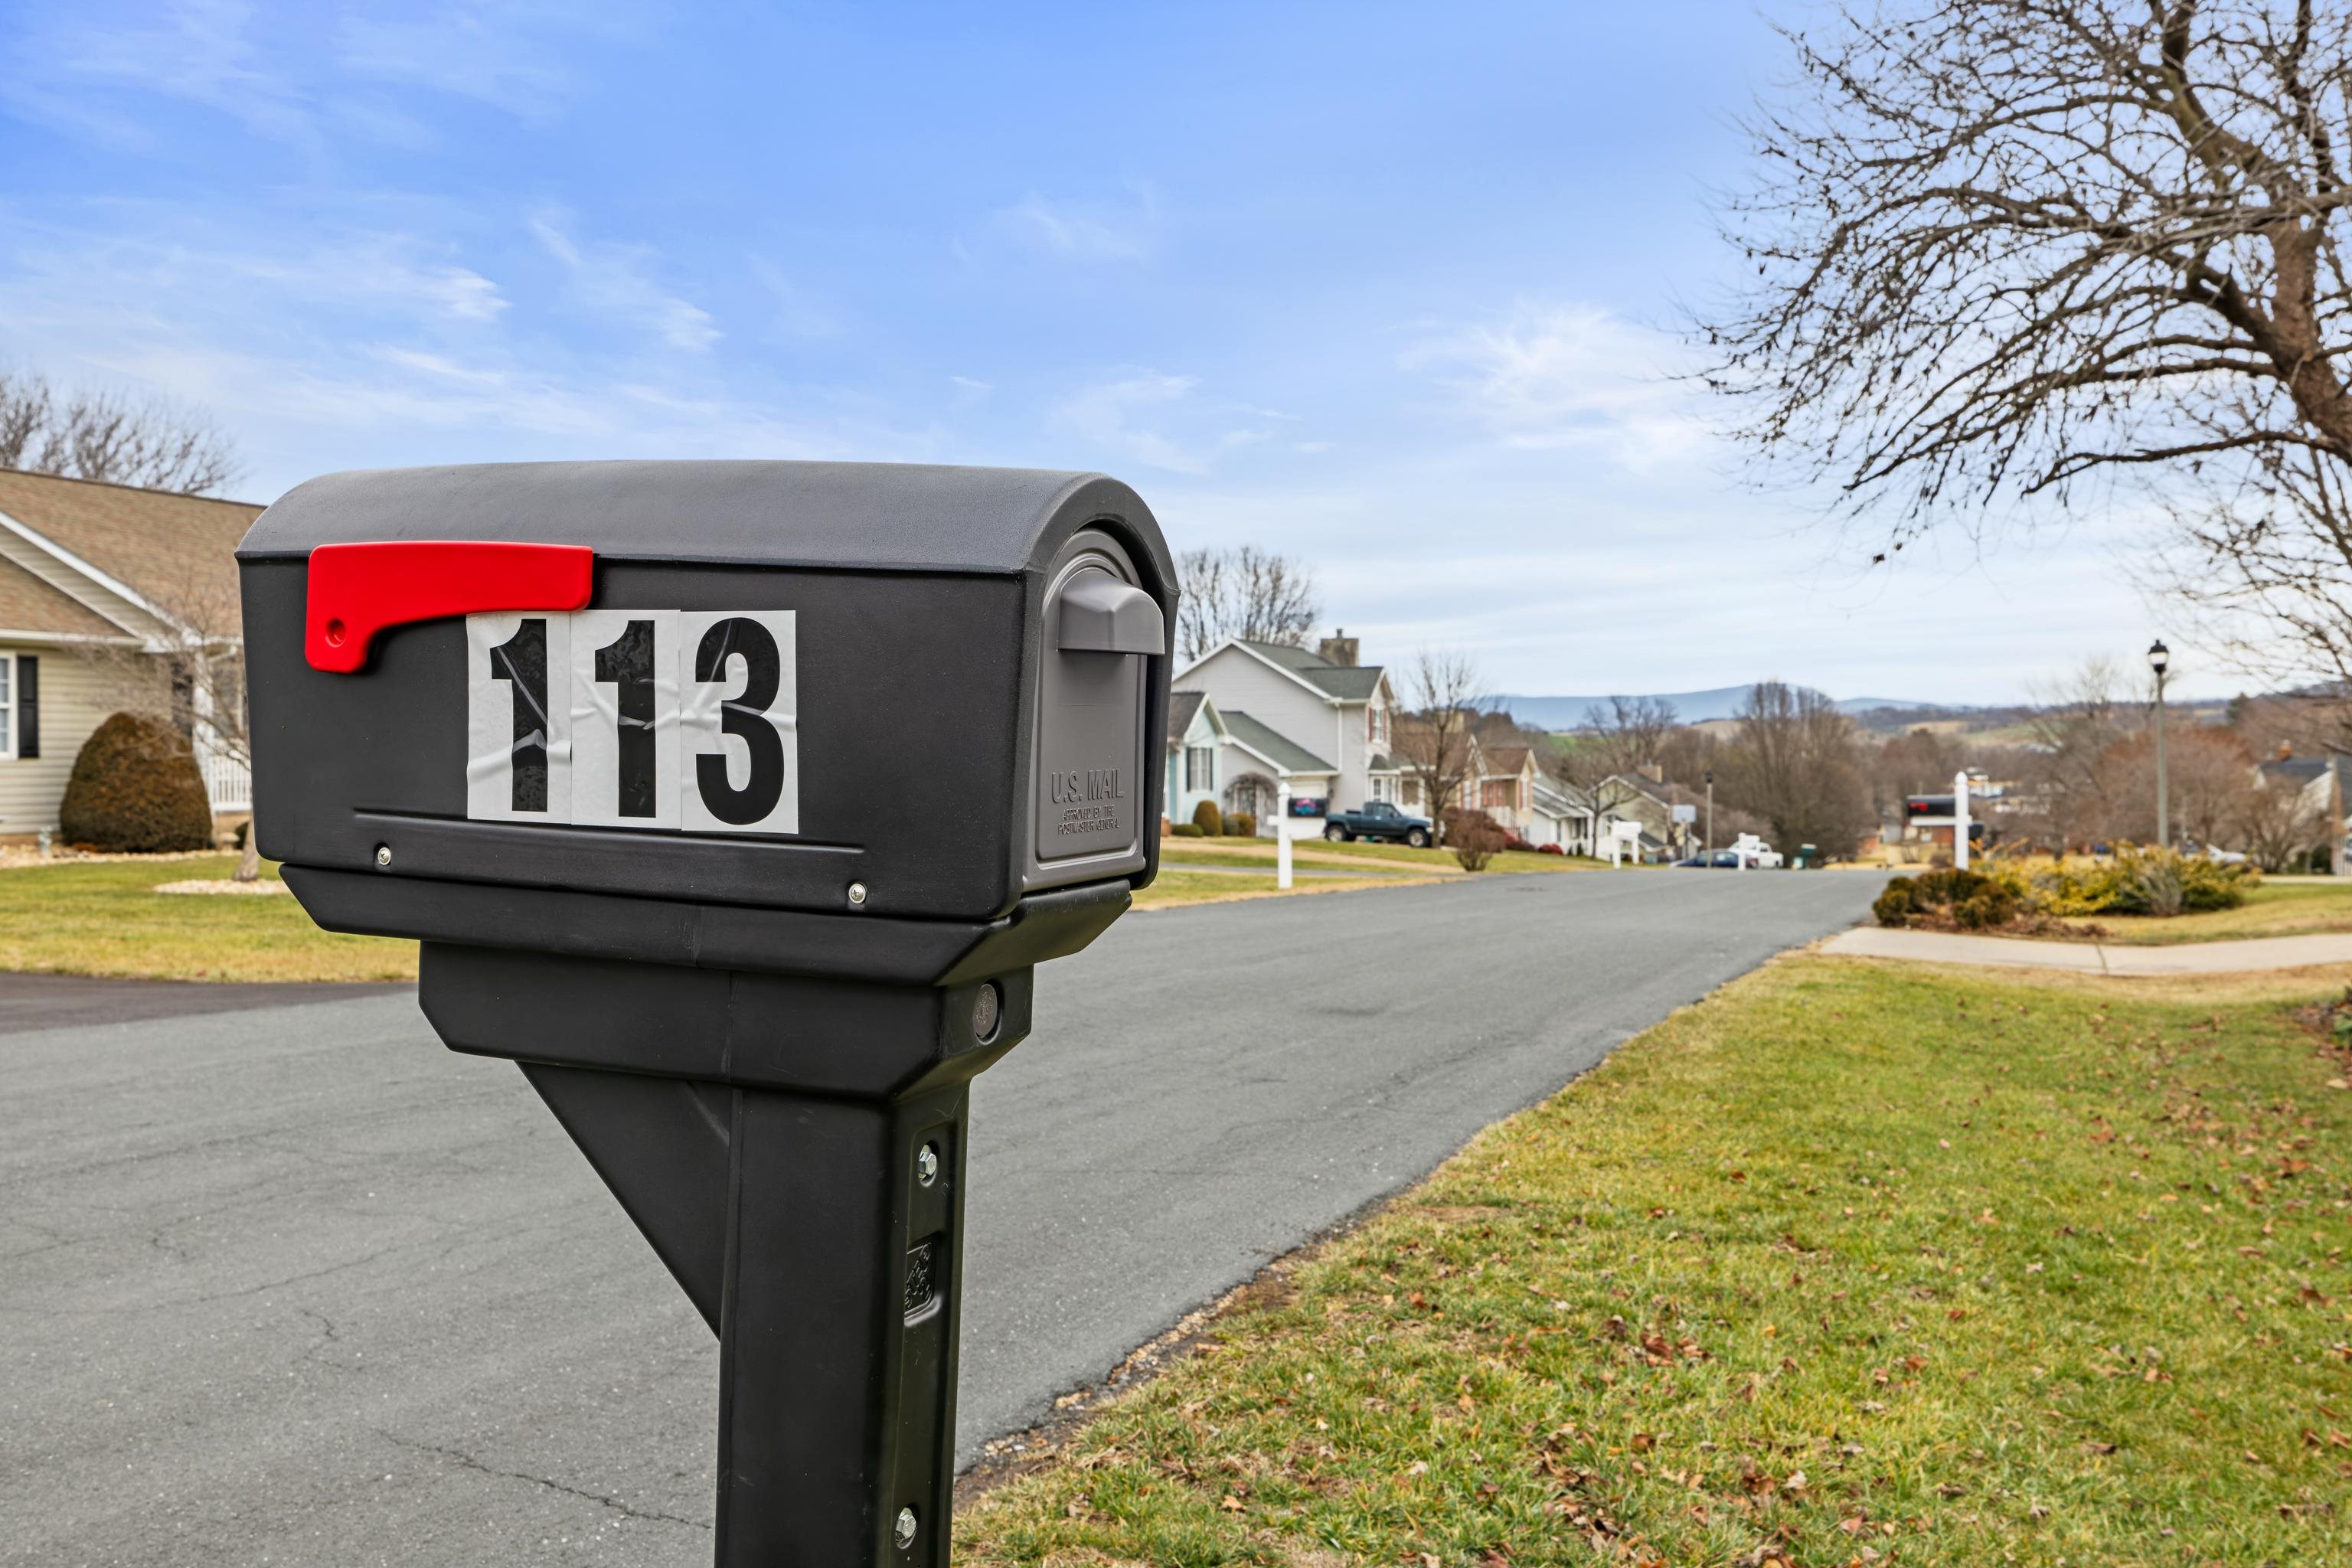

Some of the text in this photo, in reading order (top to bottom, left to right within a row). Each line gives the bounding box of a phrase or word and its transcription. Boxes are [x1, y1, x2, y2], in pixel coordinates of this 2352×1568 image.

[489, 617, 785, 825] 113
[1051, 768, 1125, 804] U.S. MAIL
[1057, 817, 1119, 835] POSTMASTER GENERAL
[1063, 805, 1115, 821] APPROVED BY THE
